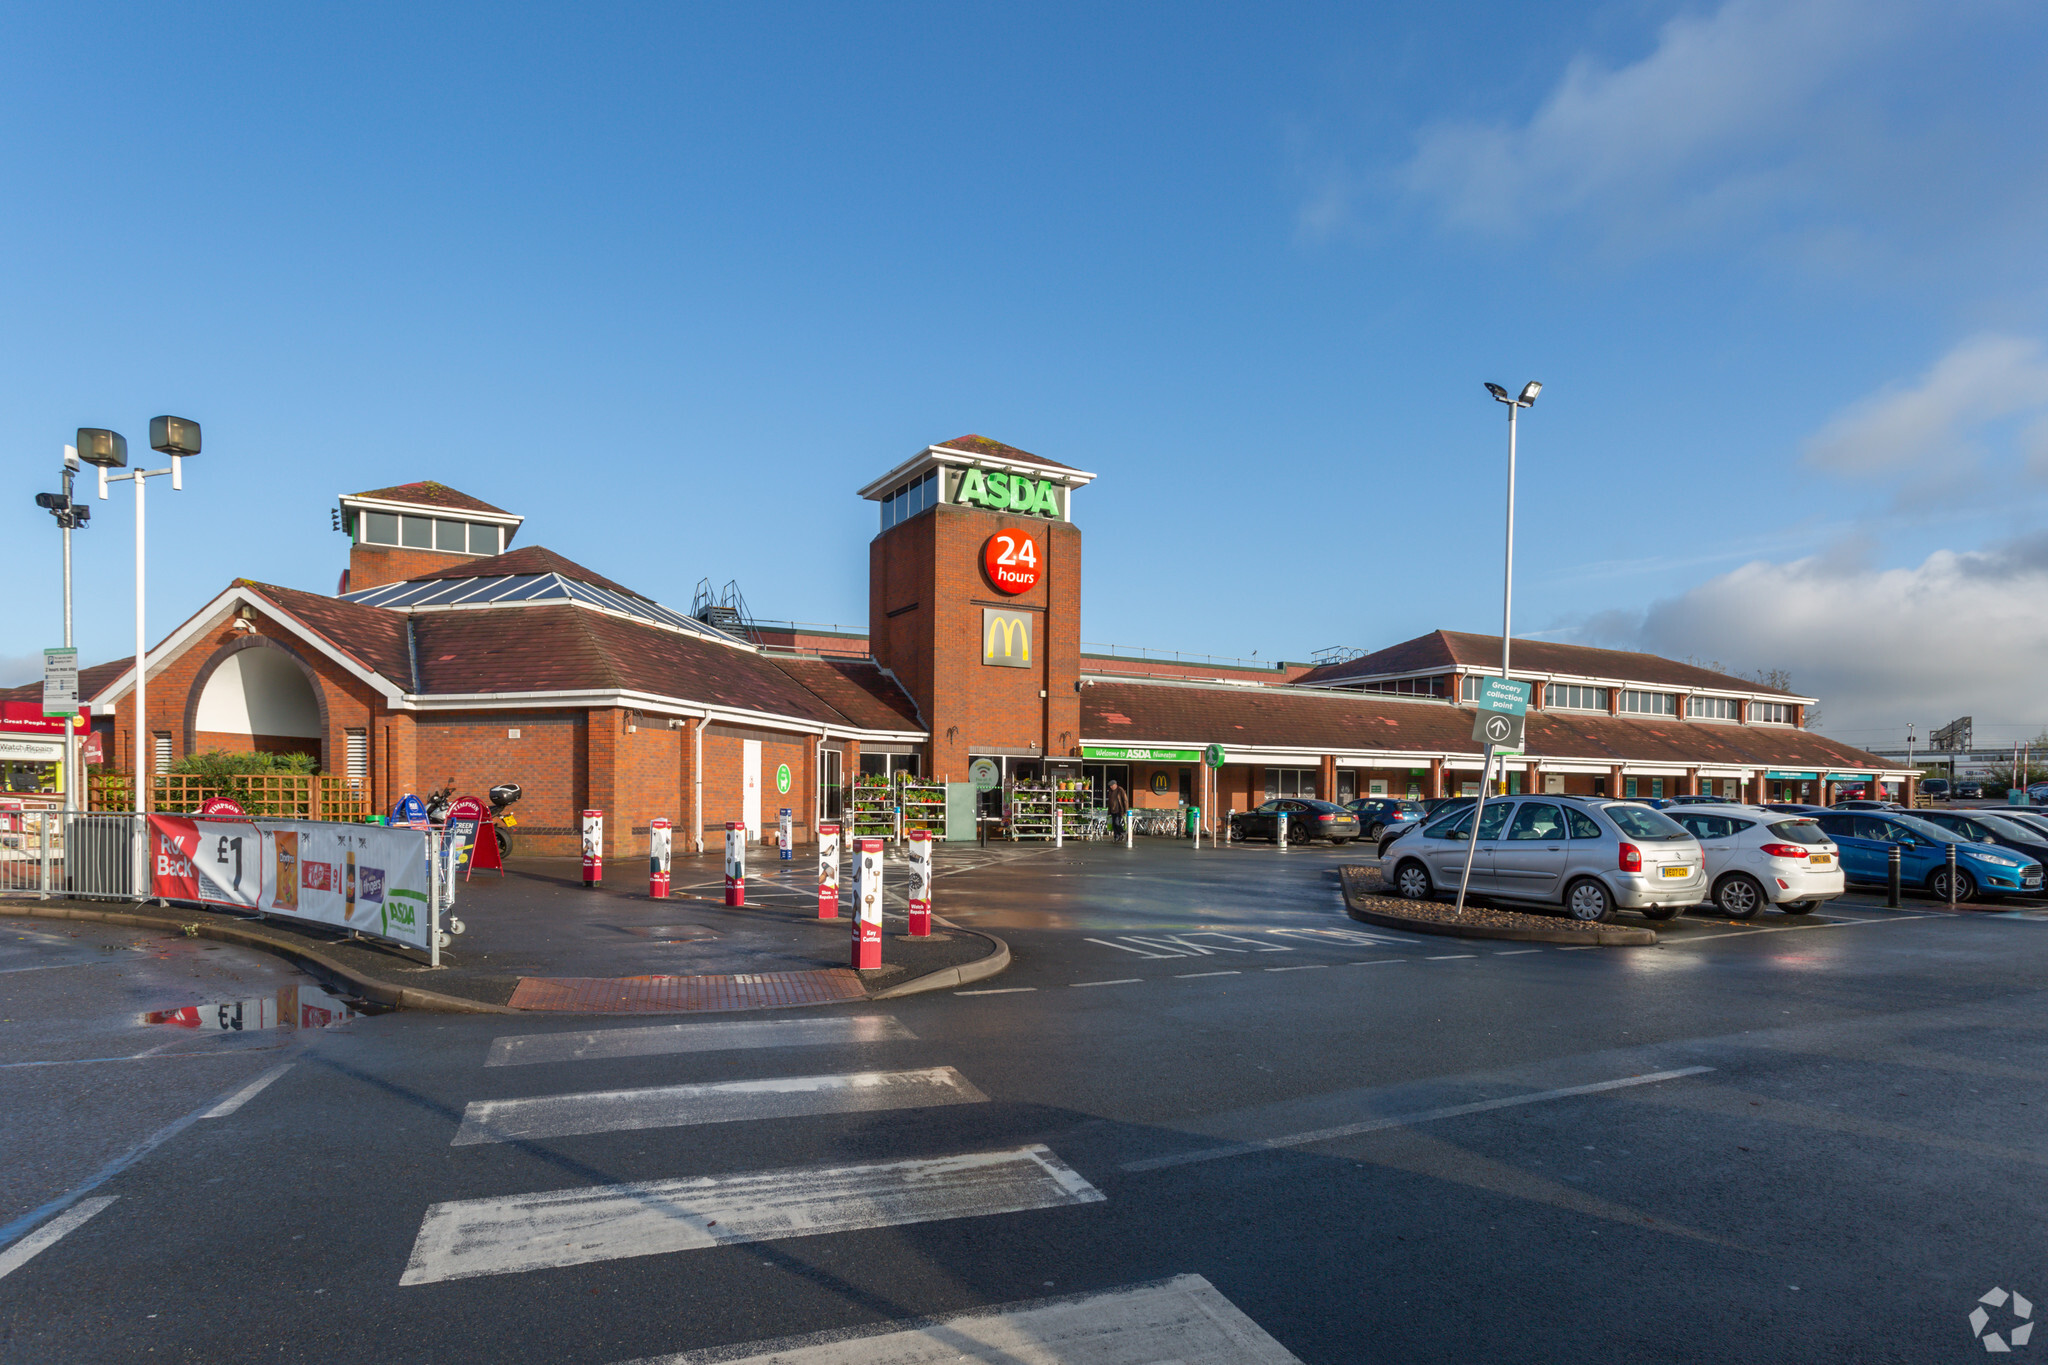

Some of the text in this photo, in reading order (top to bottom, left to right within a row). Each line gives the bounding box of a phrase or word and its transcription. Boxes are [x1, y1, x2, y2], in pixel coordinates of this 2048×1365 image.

[958, 468, 1060, 516] ASDA
[997, 536, 1037, 568] 24
[998, 567, 1034, 584] hours
[1492, 681, 1521, 694] Grocery
[1486, 690, 1523, 702] collection
[1492, 701, 1513, 710] point
[26, 745, 54, 753] Repairs
[1126, 749, 1151, 759] ASDA
[208, 803, 240, 814] TIMPSON
[453, 801, 480, 812] TIMPSON
[157, 855, 193, 877] Back
[217, 836, 243, 891] £1
[389, 902, 416, 926] ASDA
